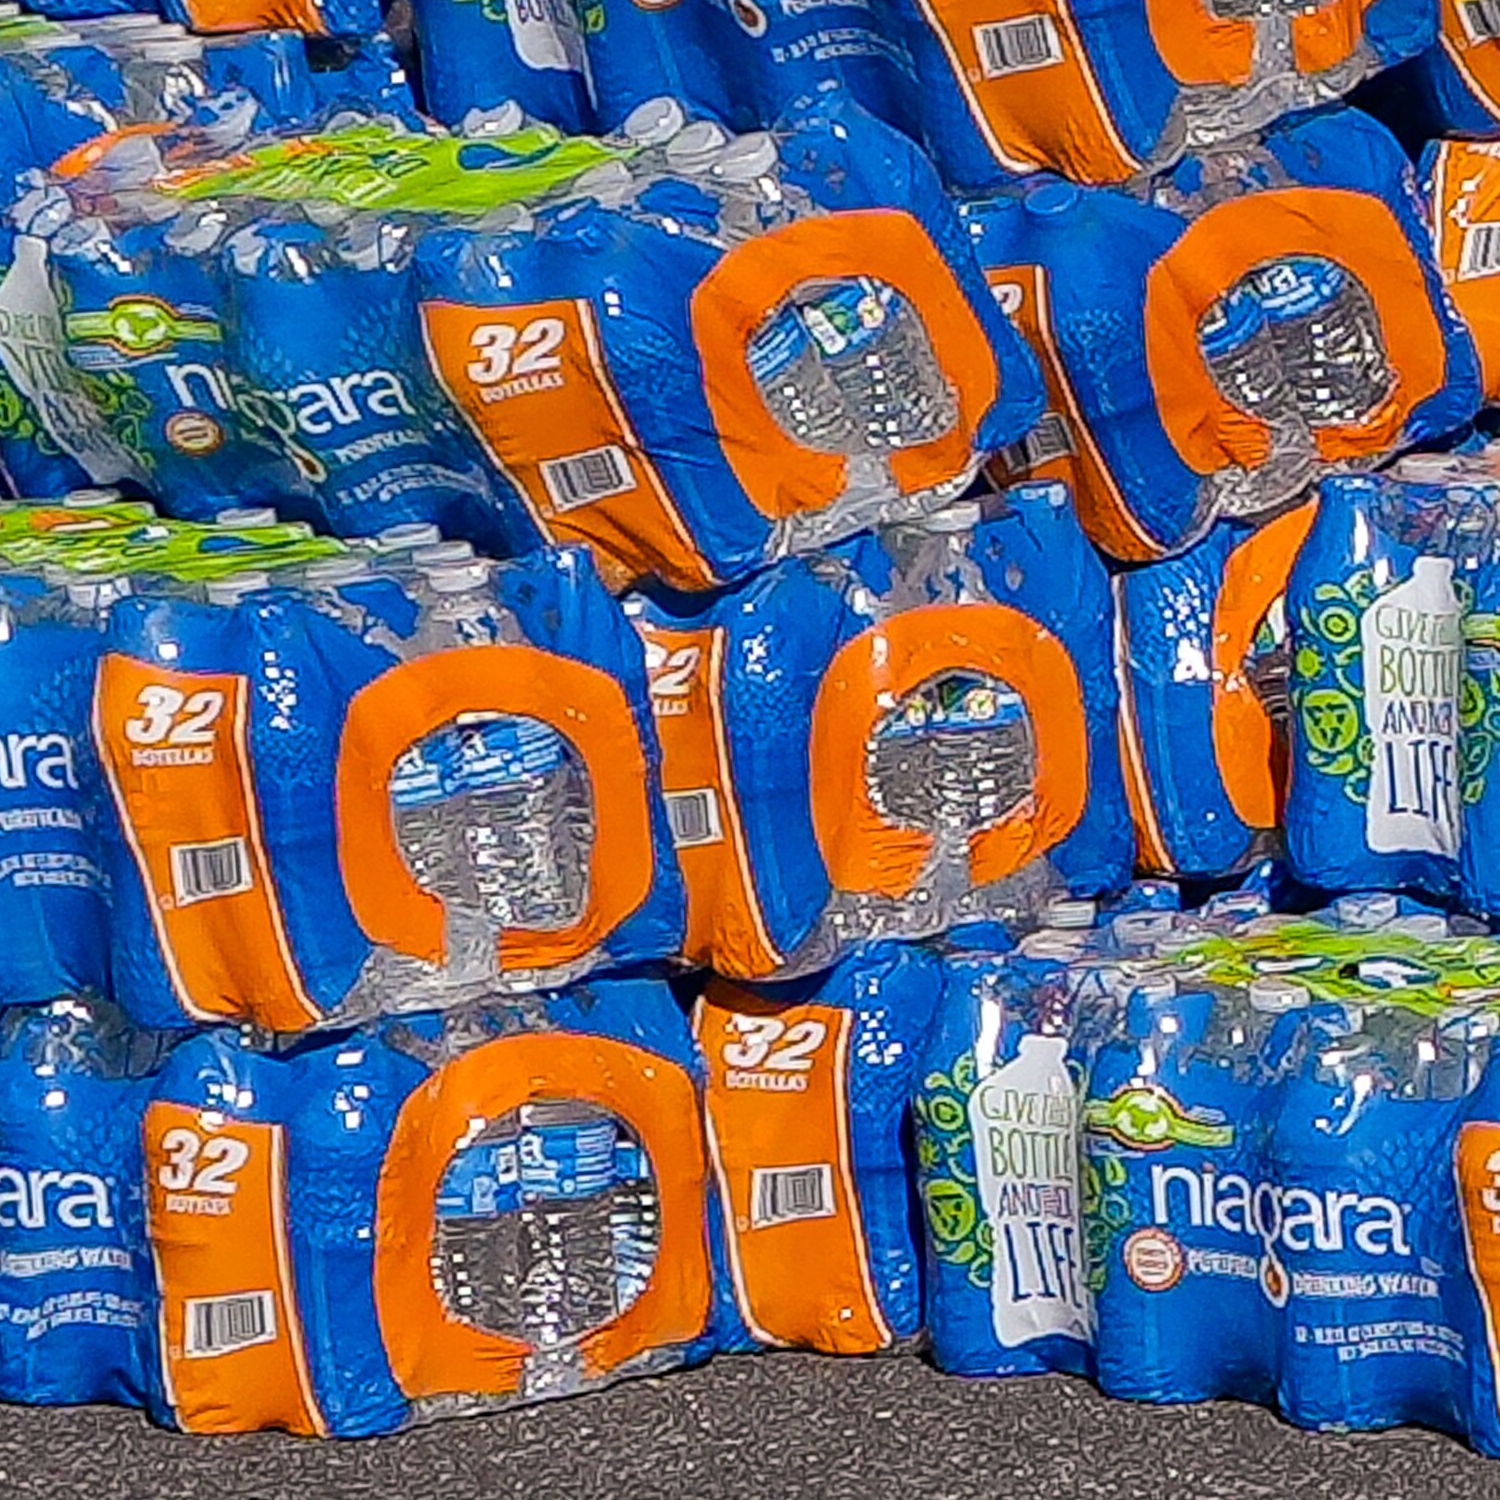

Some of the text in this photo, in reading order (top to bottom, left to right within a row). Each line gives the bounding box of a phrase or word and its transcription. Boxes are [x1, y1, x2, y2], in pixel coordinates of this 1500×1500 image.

[467, 318, 565, 384] 32
[125, 685, 226, 745] 32
[722, 1012, 827, 1070] 32
[724, 1069, 809, 1093] BOTELLAS
[159, 1128, 249, 1193] 32
[1150, 1163, 1411, 1288] niagara
[1002, 1221, 1083, 1308] LIFE
